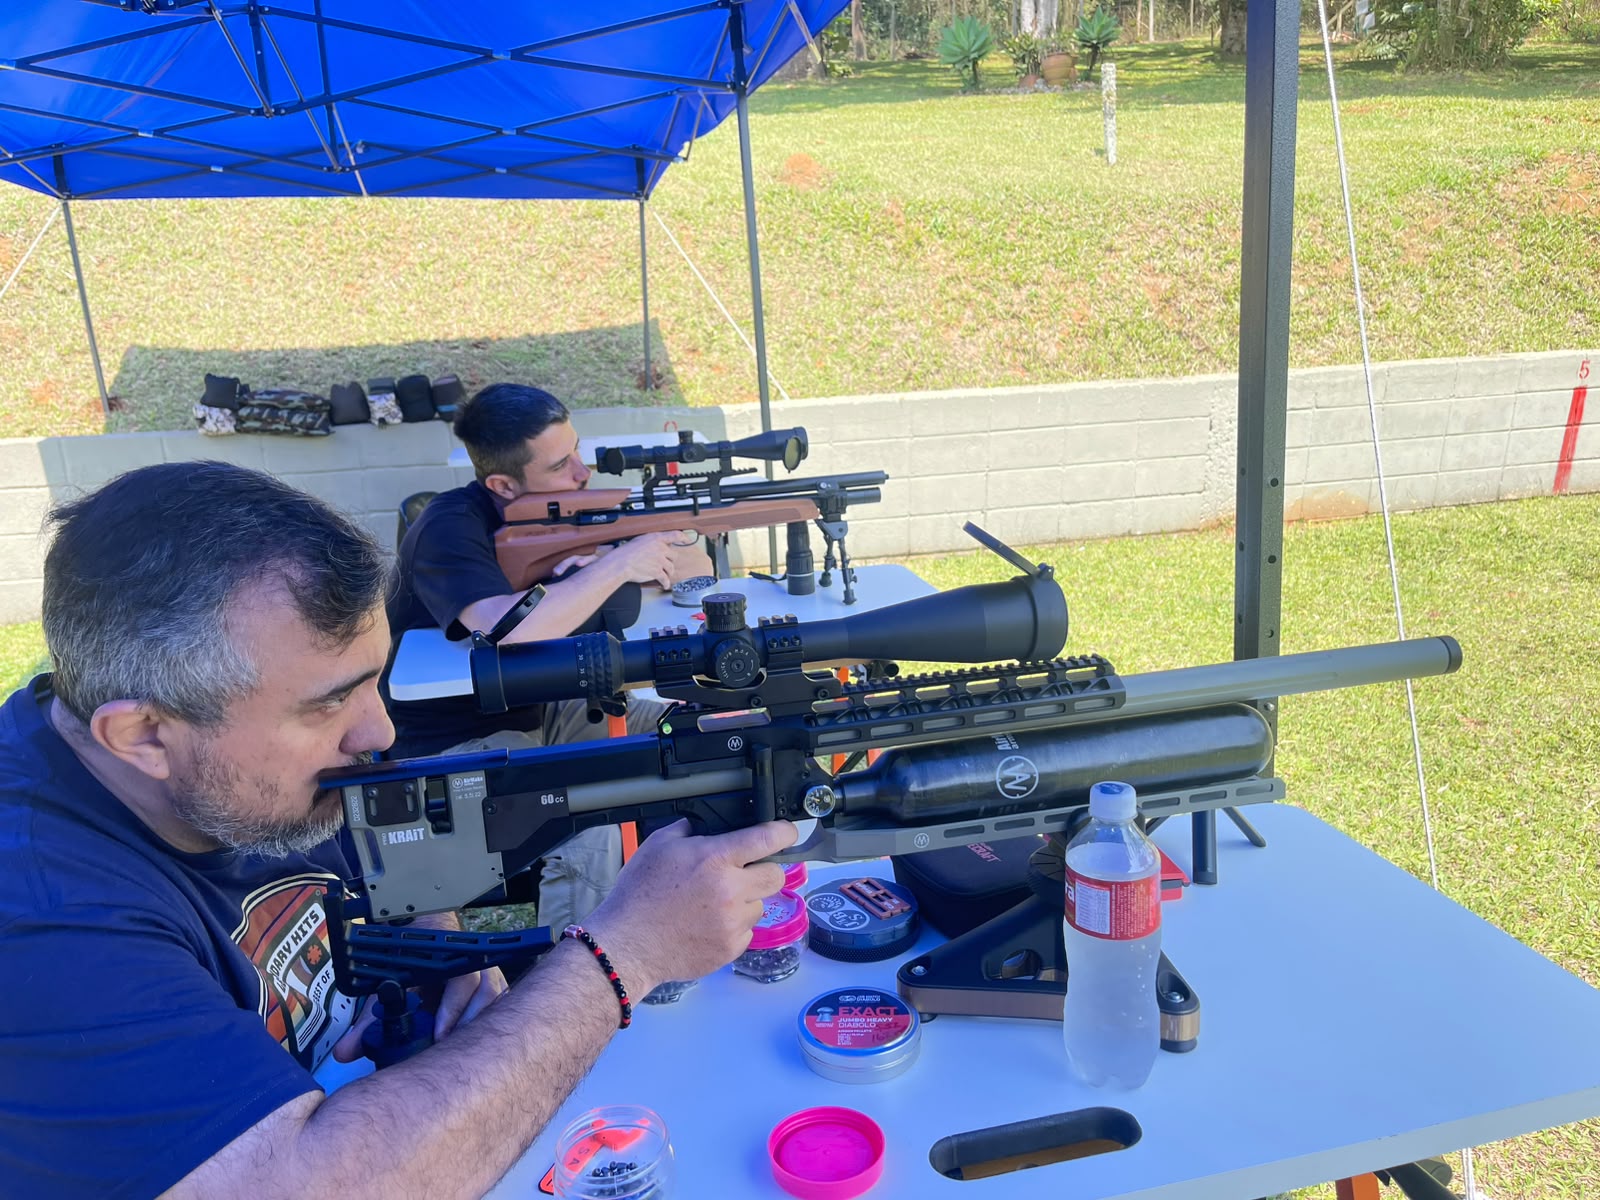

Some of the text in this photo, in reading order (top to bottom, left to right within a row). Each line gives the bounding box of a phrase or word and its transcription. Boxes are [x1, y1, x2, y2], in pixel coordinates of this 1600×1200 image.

[1579, 359, 1590, 379] 5
[293, 910, 321, 945] HITS
[321, 970, 332, 984] OF
[838, 1006, 898, 1016] EXACT
